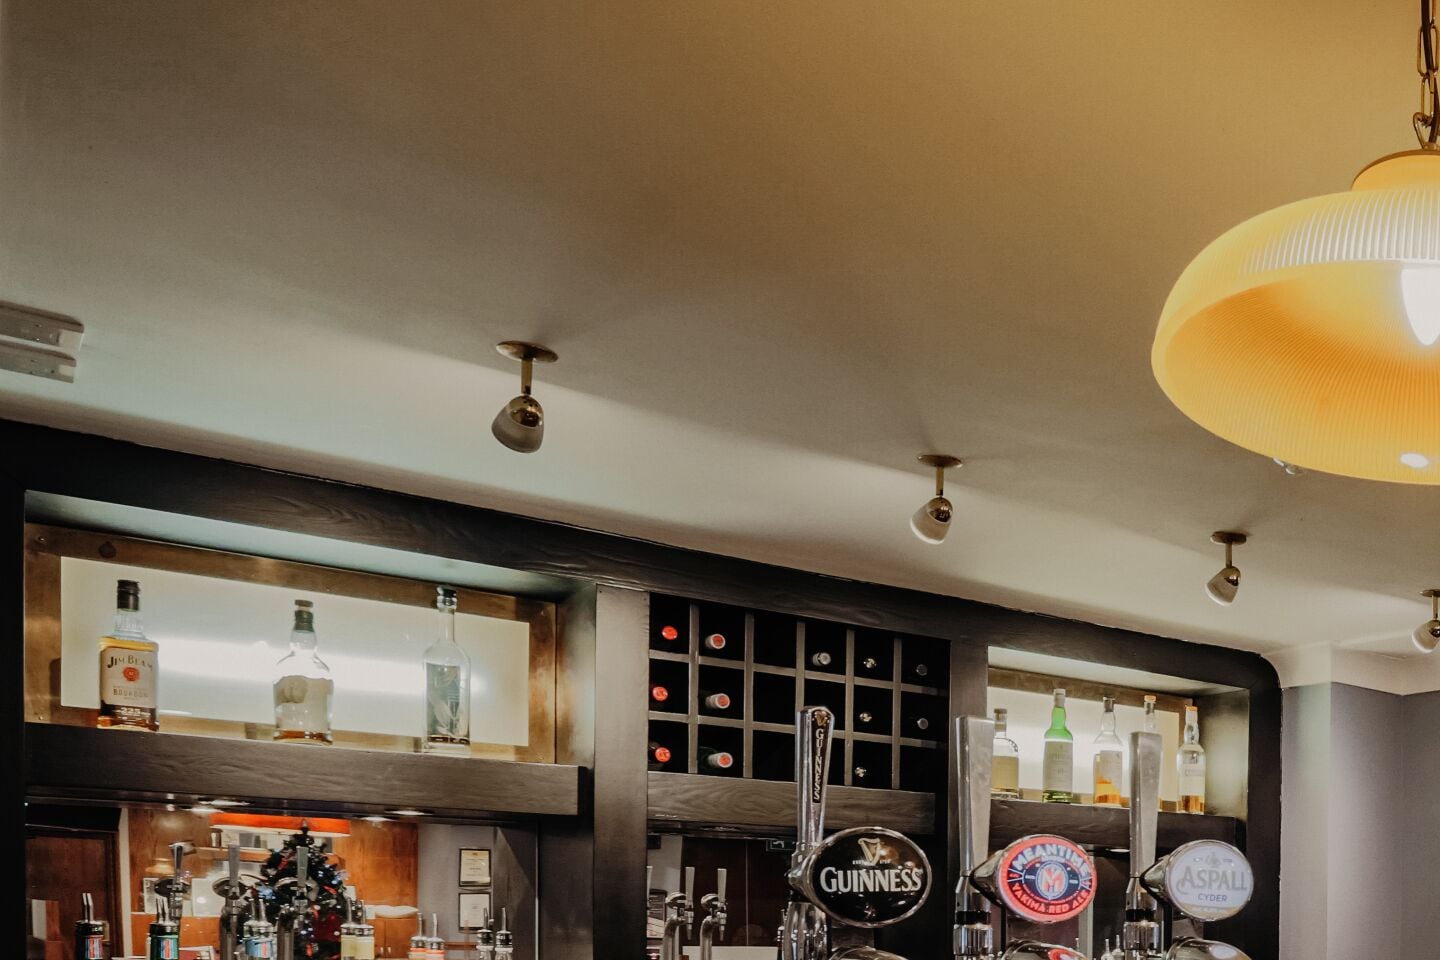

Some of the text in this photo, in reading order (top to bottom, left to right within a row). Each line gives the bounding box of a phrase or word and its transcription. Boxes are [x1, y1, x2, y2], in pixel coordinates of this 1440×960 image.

[812, 728, 826, 801] GUINNESS
[1012, 844, 1093, 878] MEANTIME
[819, 866, 924, 893] GUINNESS
[1176, 865, 1249, 895] ASPALL
[1198, 893, 1228, 902] CYDER
